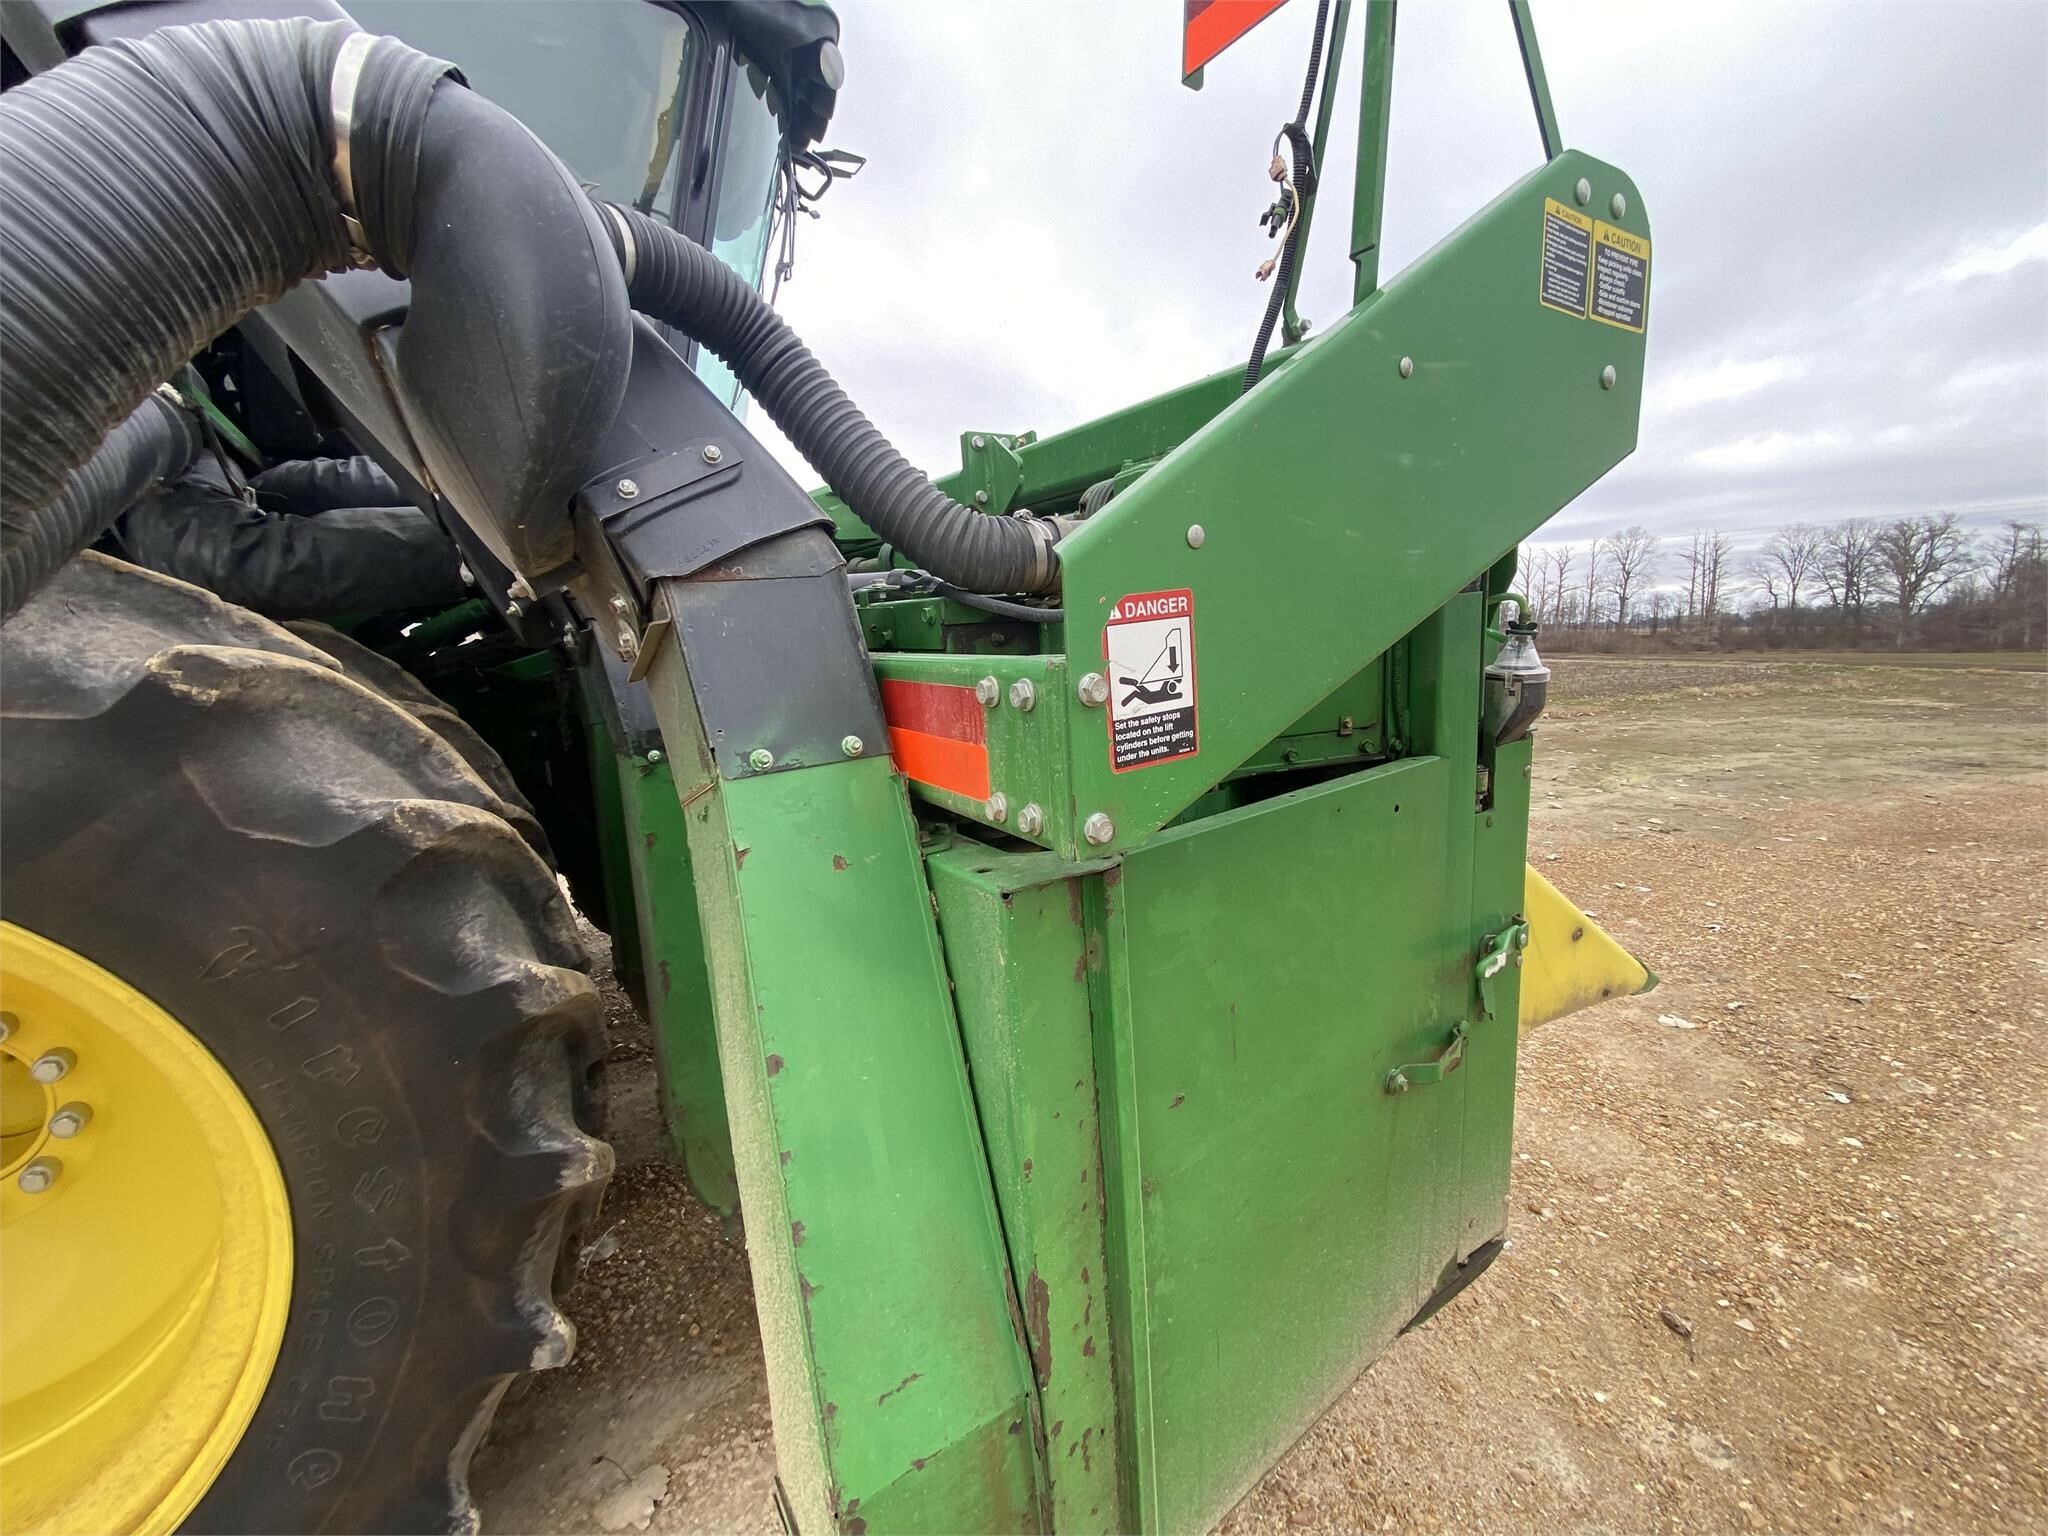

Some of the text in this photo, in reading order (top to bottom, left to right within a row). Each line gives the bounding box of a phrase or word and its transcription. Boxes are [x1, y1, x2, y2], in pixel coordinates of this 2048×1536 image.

[1611, 233, 1641, 254] CAUTION
[1124, 597, 1188, 619] DANGER
[1115, 712, 1181, 731] Set the safety stops
[1115, 722, 1174, 741] located on the lift
[1116, 729, 1194, 753] cylinders before getting
[1117, 752, 1138, 763] under
[1138, 748, 1150, 758] the
[1150, 746, 1170, 755] units.
[193, 924, 414, 1493] Firestone
